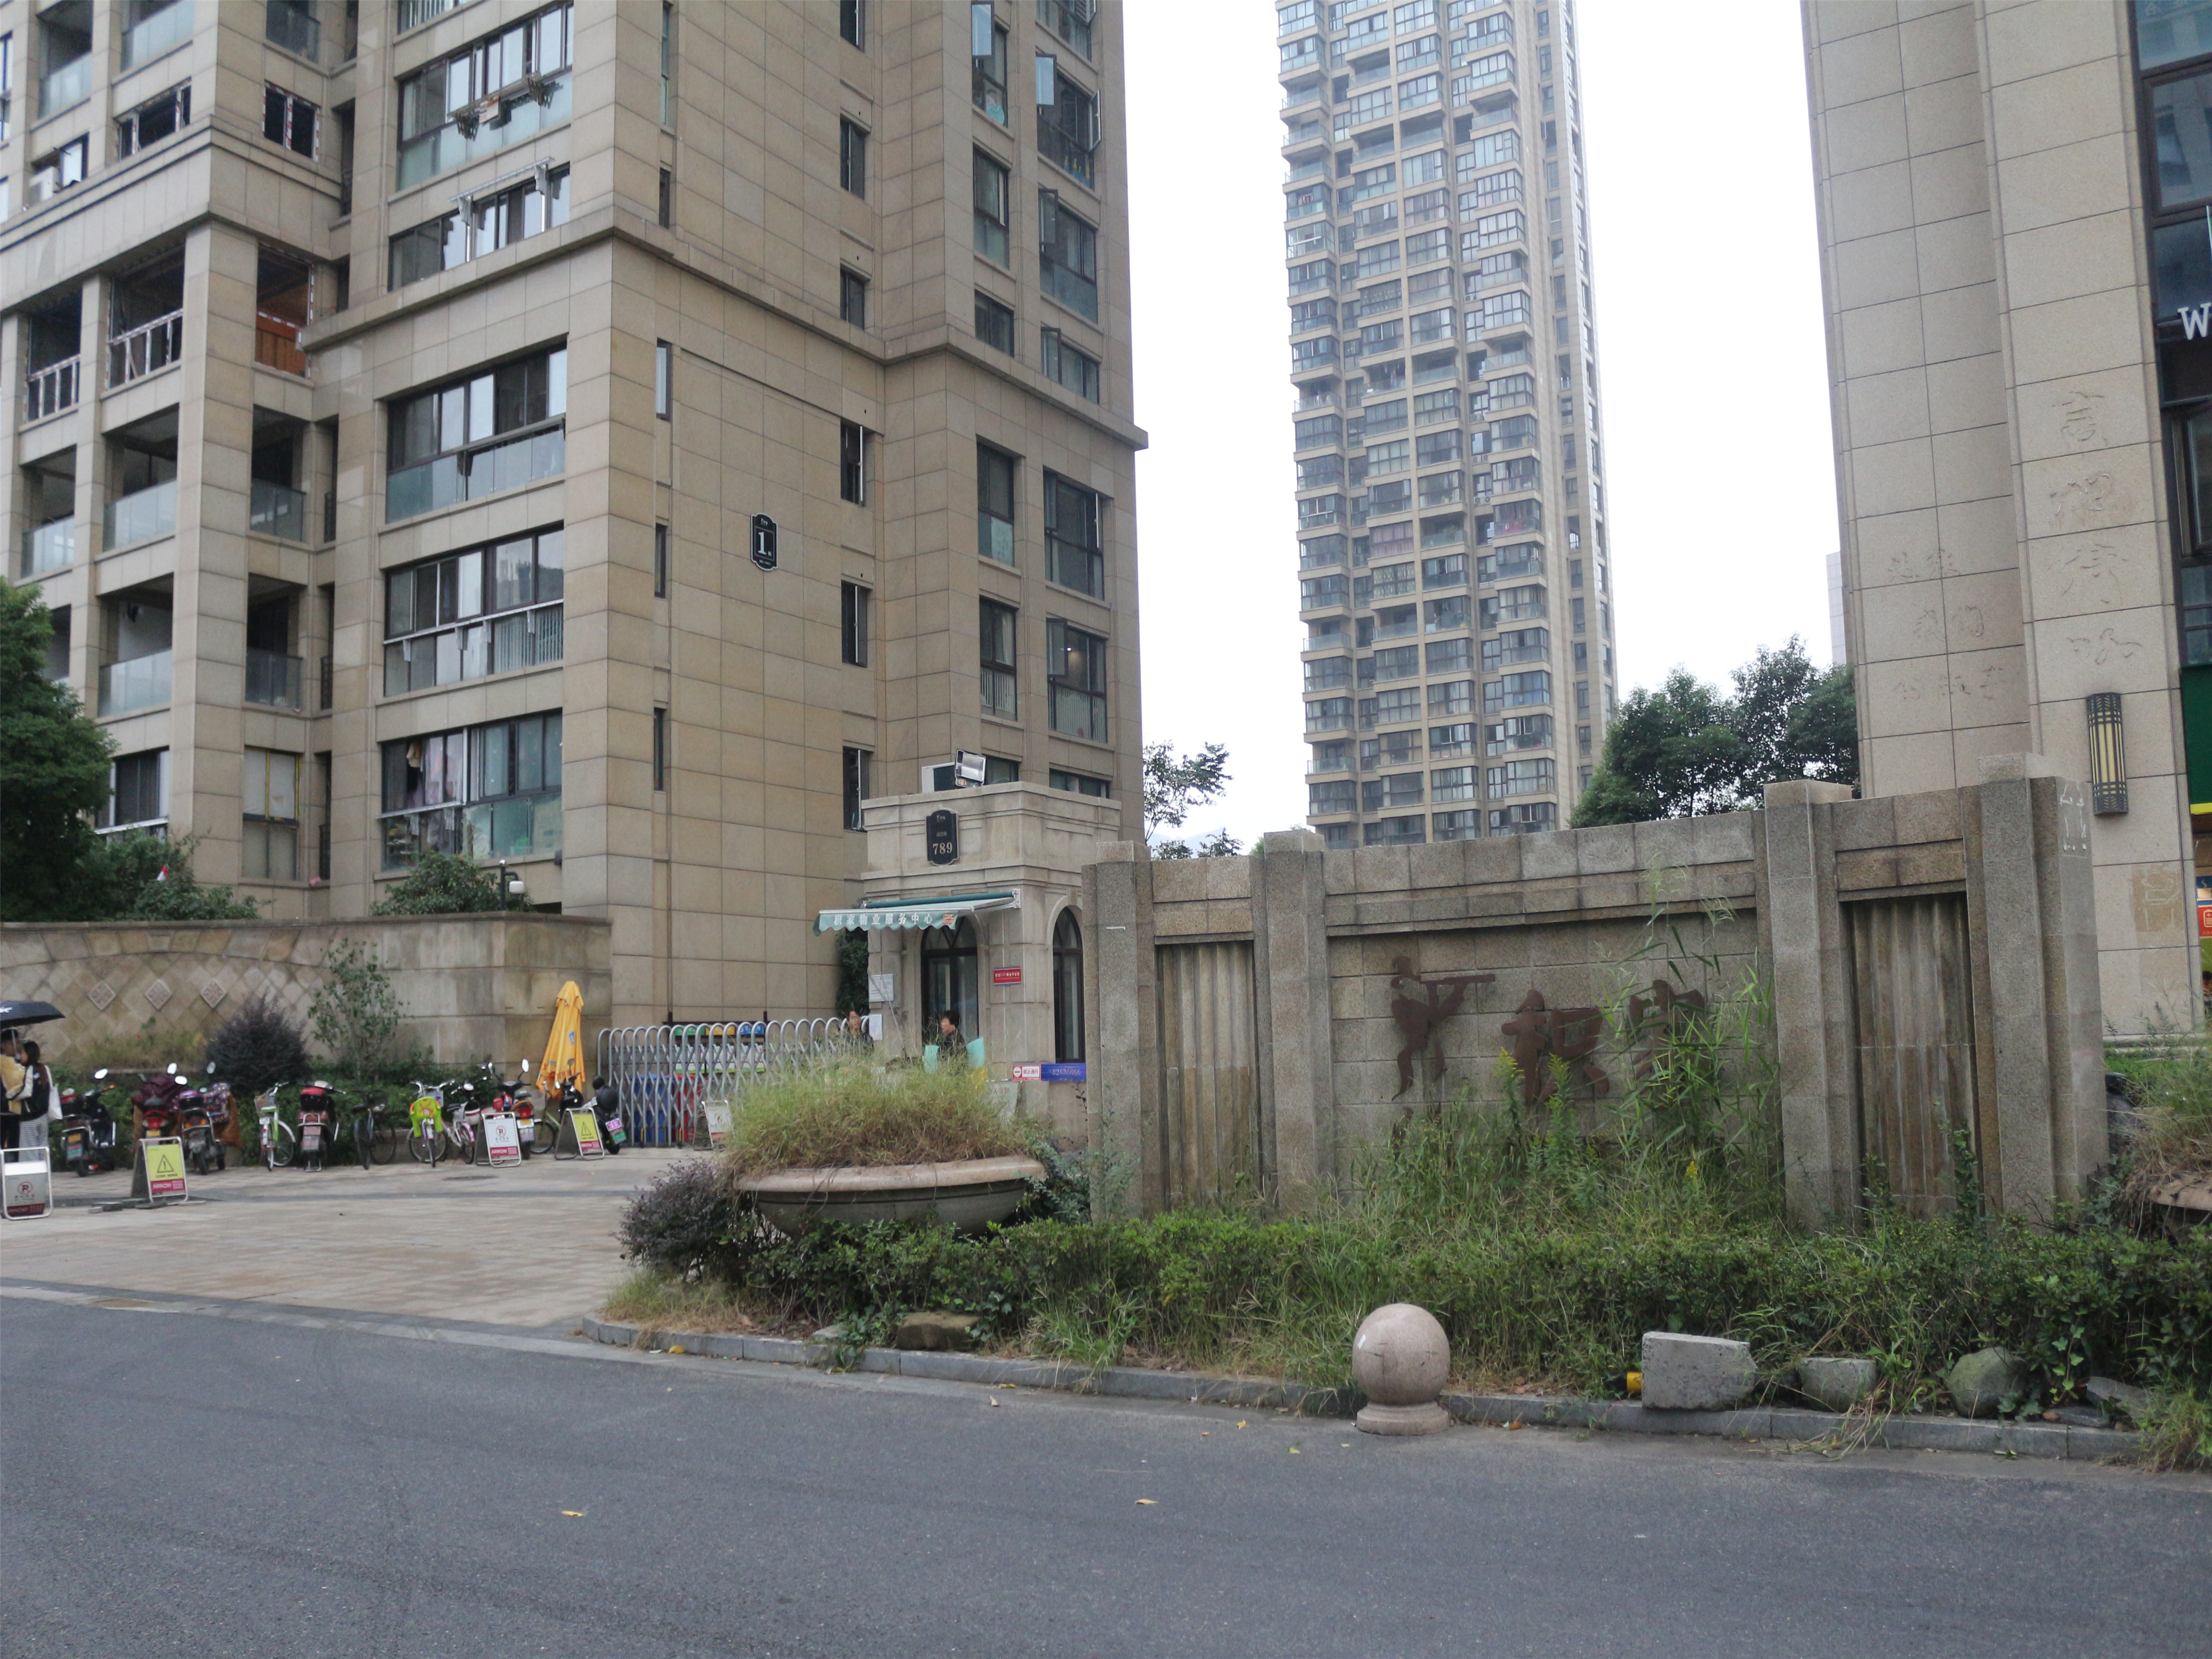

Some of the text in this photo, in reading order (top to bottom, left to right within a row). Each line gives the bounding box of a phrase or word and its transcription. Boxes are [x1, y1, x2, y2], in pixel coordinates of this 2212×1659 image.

[758, 531, 766, 555] 1
[932, 842, 953, 855] 789
[833, 913, 933, 926] 积家物业服务中心
